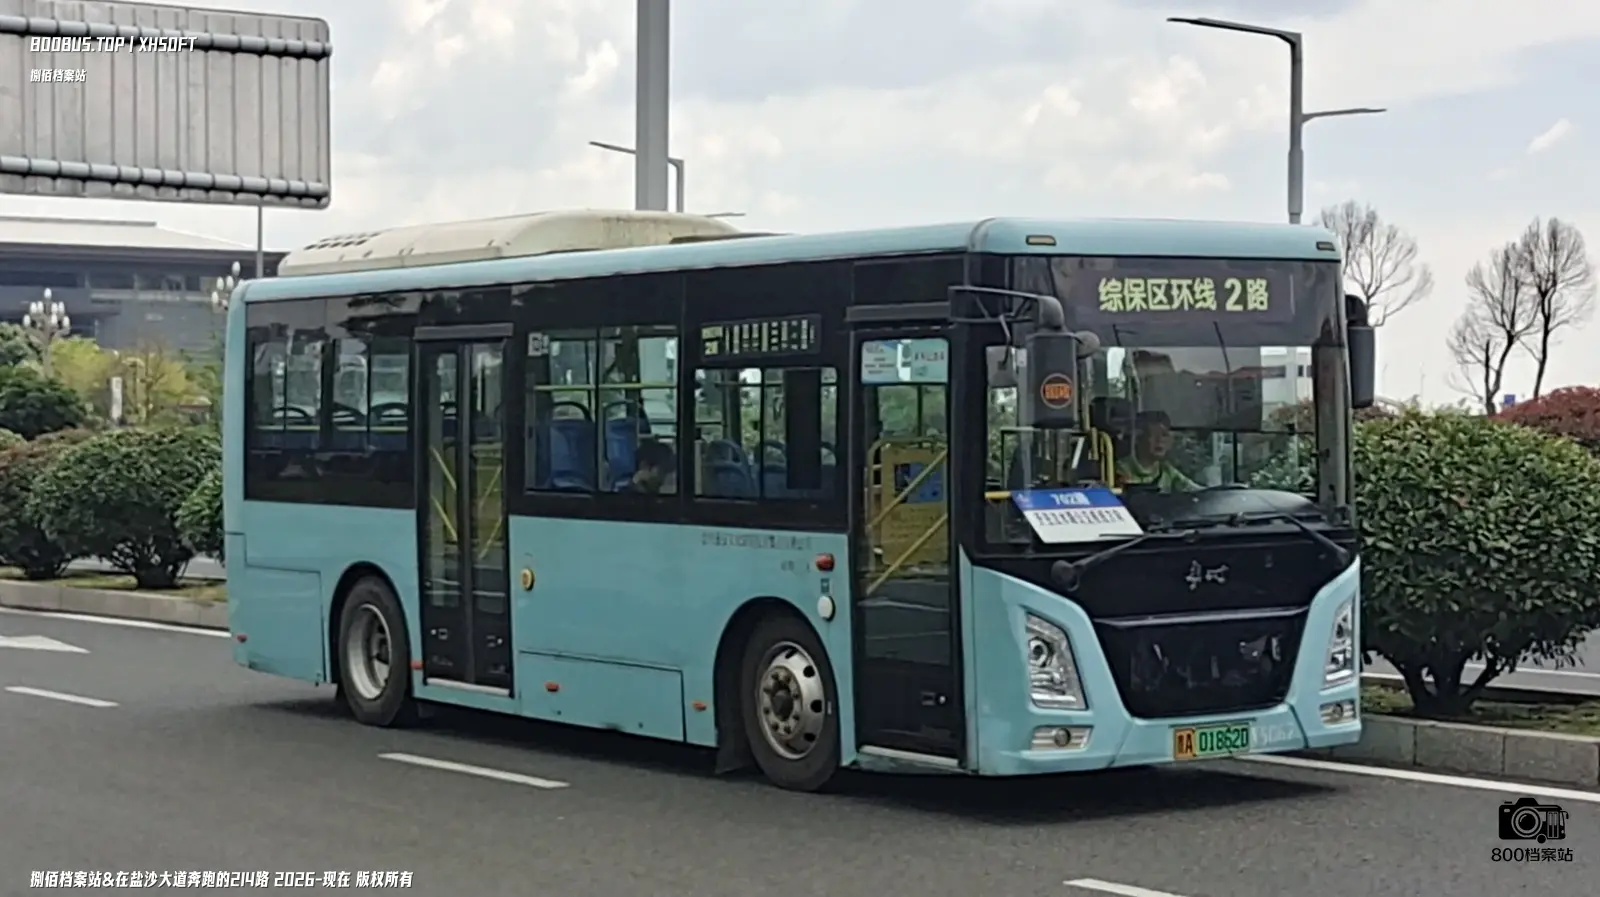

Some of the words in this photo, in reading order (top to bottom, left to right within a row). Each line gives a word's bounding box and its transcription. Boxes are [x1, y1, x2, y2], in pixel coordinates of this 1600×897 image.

[1098, 277, 1217, 312] 综保区环线
